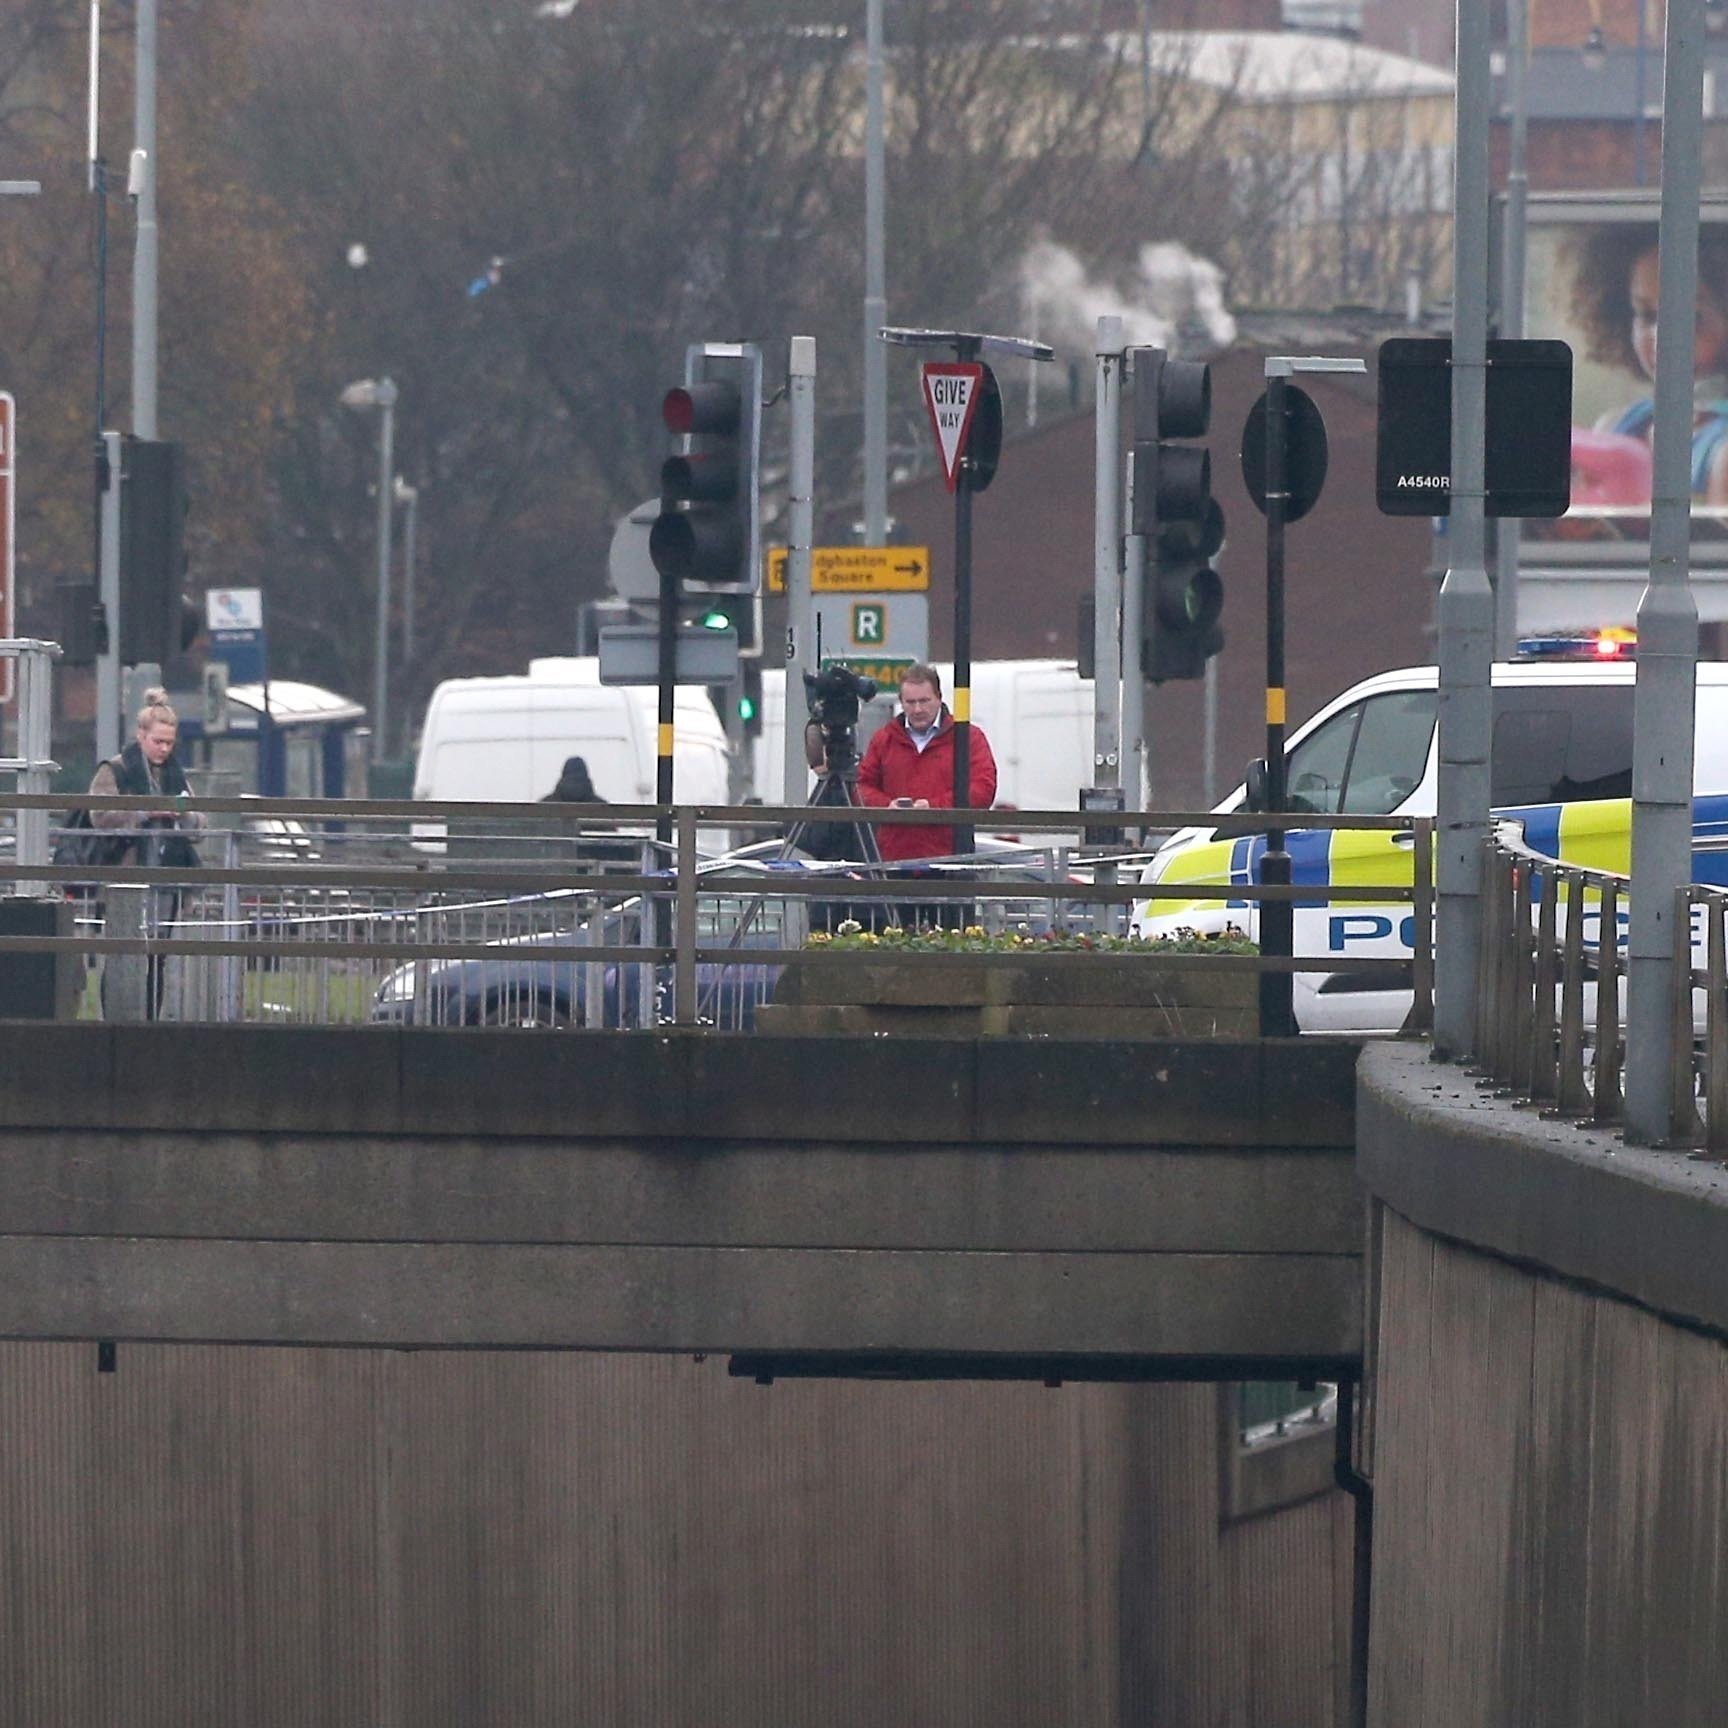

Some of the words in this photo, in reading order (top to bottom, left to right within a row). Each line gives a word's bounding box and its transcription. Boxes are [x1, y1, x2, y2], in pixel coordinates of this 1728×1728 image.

[934, 379, 967, 405] GIVE
[939, 412, 960, 428] WAY
[815, 554, 887, 570] dgbaston
[858, 611, 878, 639] R
